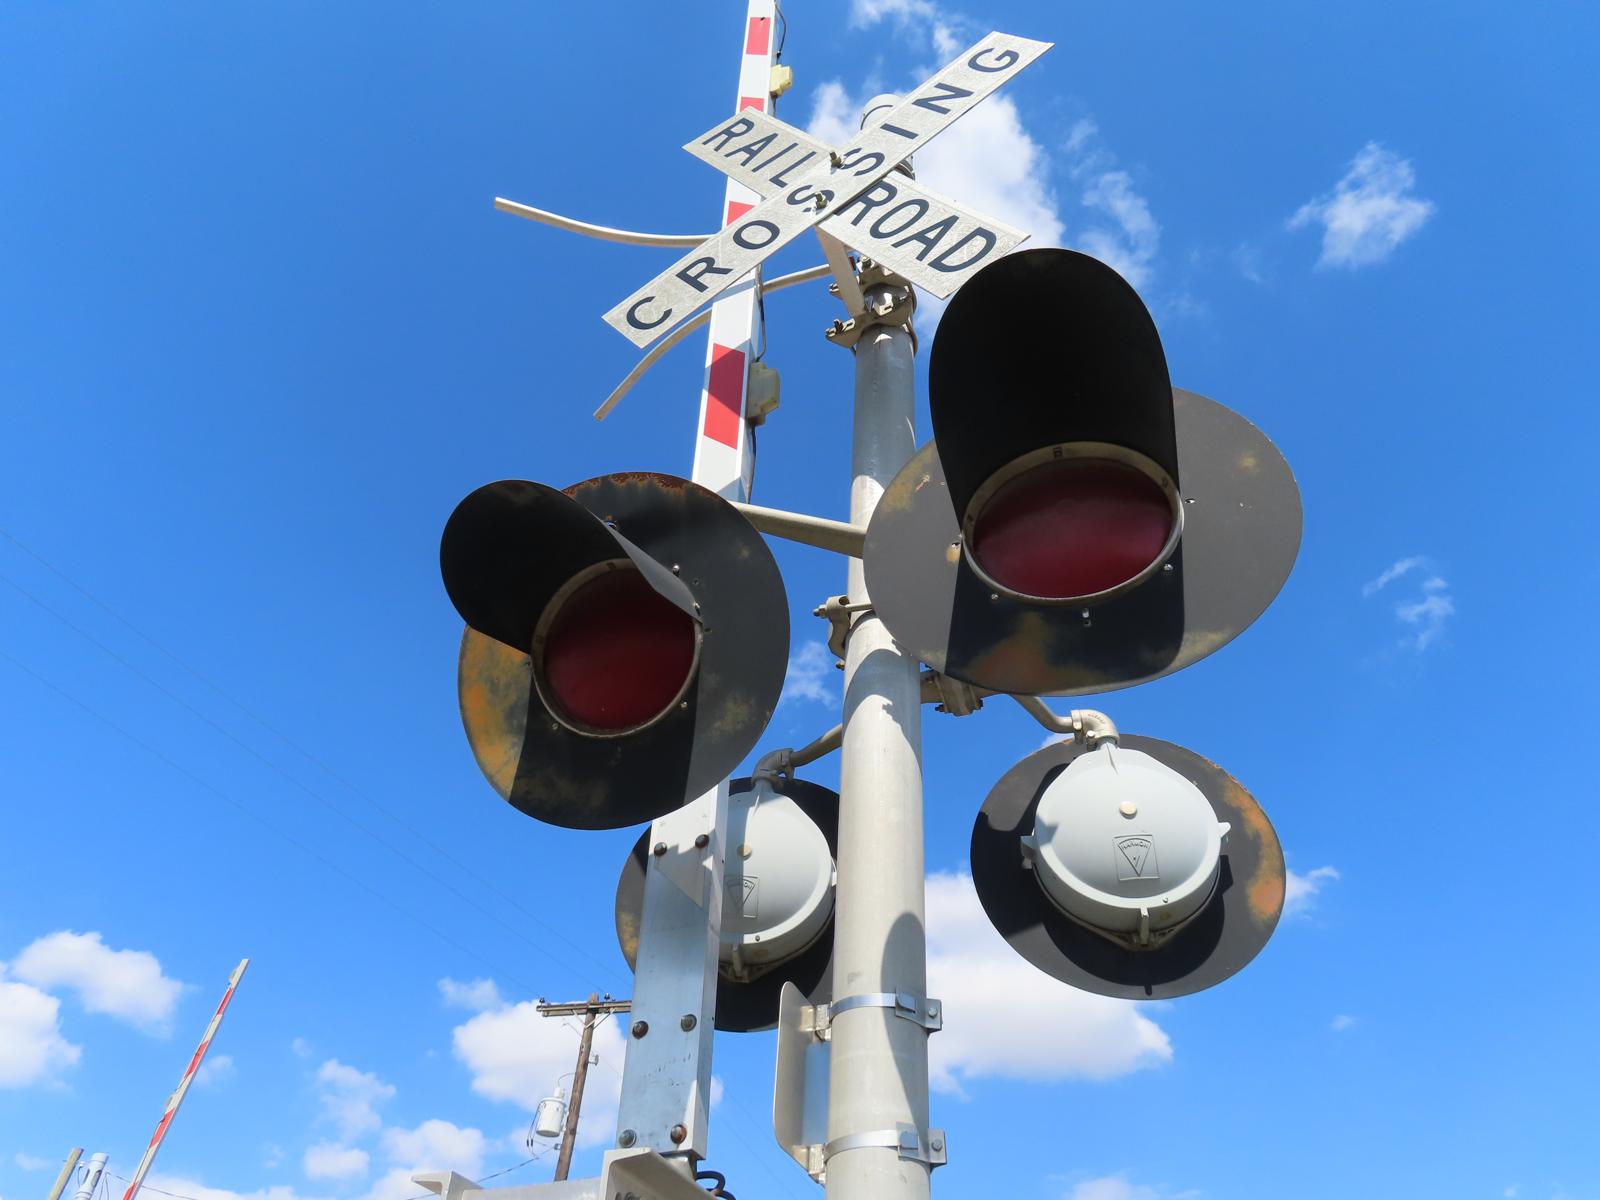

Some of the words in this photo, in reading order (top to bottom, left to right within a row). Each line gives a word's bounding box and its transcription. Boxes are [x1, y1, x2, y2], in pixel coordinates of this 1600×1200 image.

[626, 47, 1020, 330] CROSSING
[702, 117, 817, 188] RAIL
[834, 180, 997, 273] ROAD
